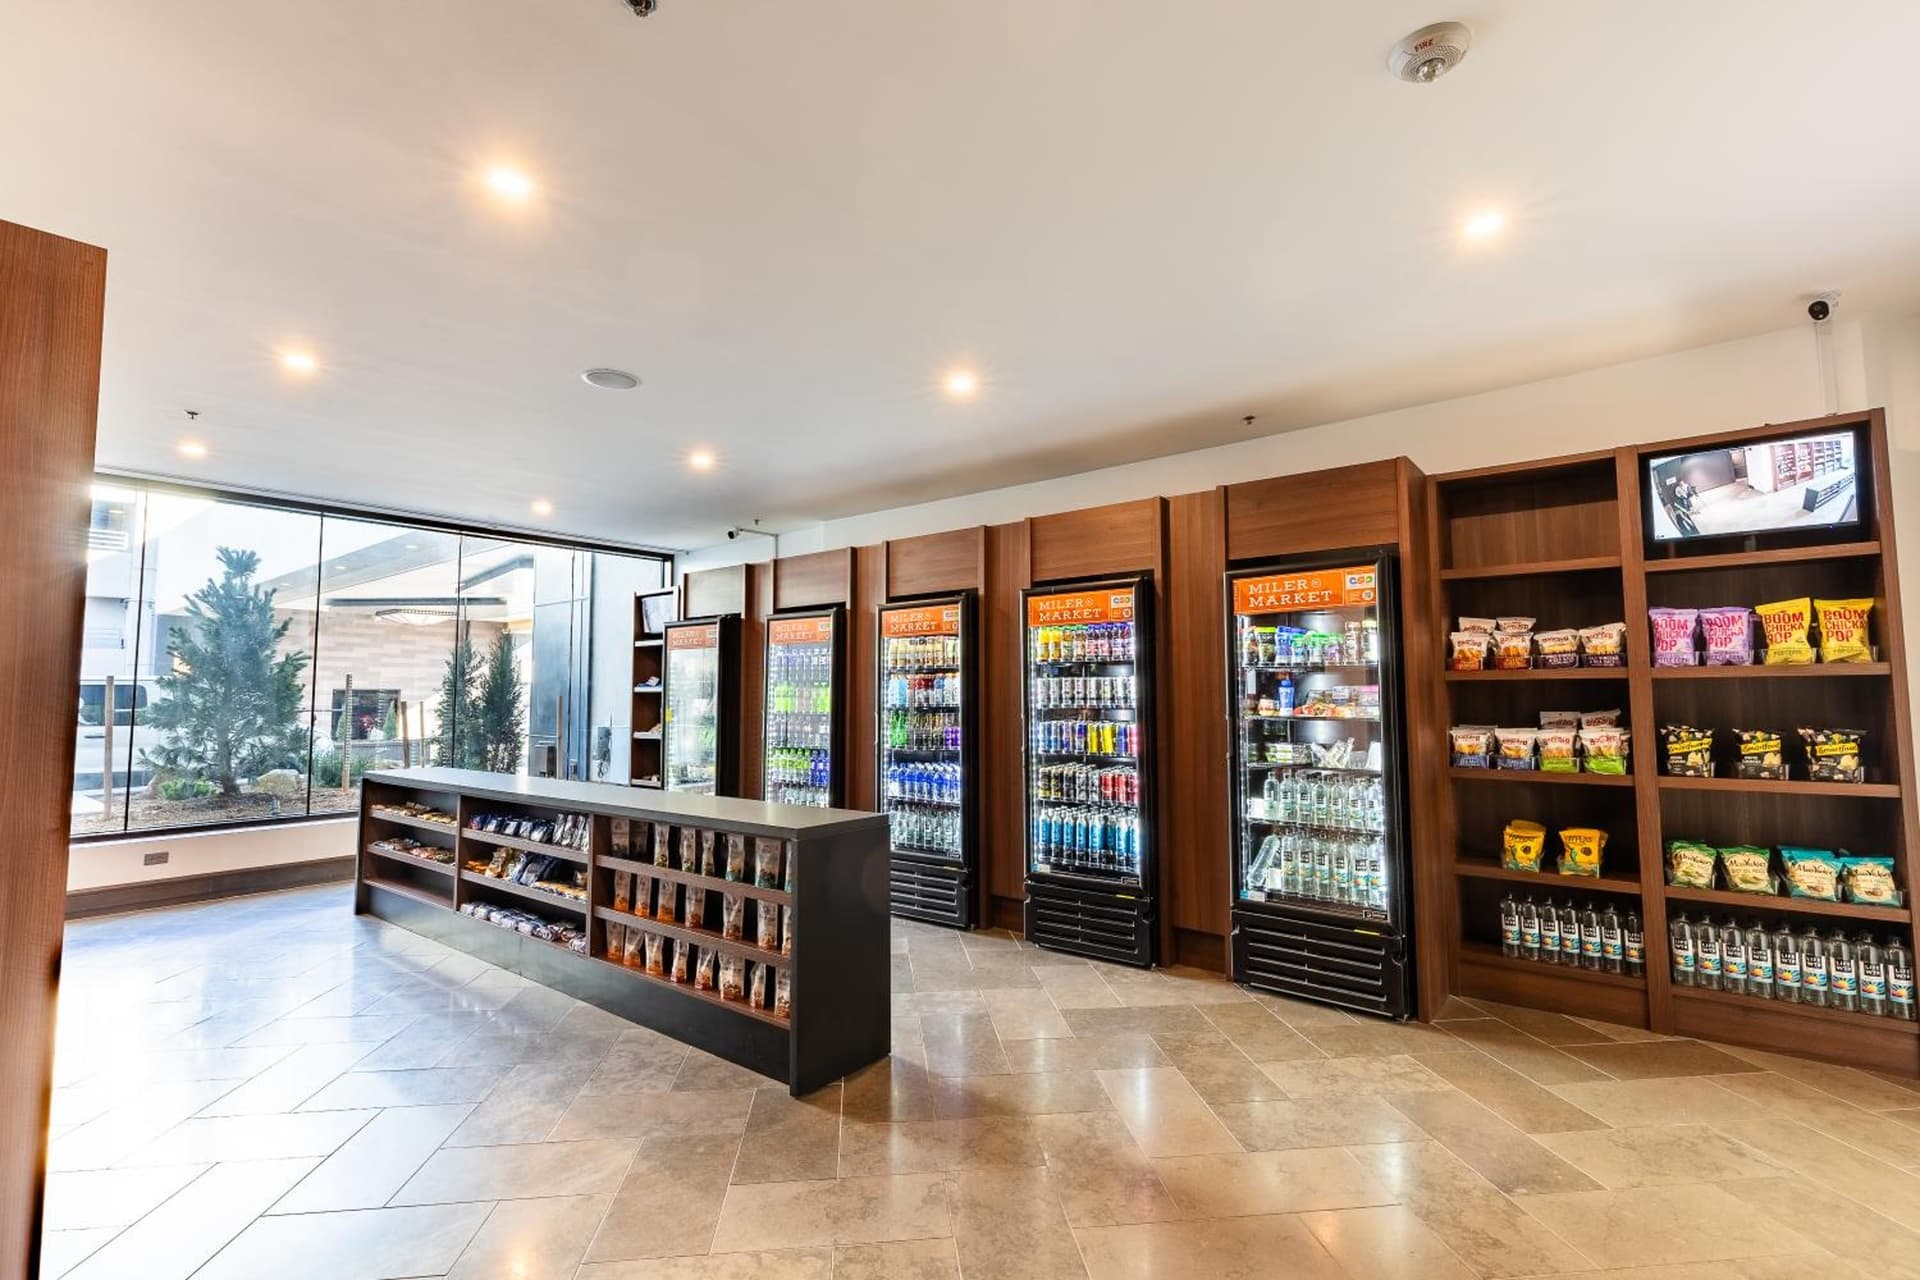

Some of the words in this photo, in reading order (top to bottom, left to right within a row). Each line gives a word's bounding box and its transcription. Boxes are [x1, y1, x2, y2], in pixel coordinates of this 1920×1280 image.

[1414, 39, 1434, 52] FIRE
[1248, 579, 1308, 595] MILER
[1039, 598, 1083, 611] MILER
[1248, 590, 1333, 607] MARKET
[1039, 608, 1102, 622] MARKET
[1705, 615, 1744, 628] BOOM
[1764, 611, 1804, 625] BOOM
[1823, 609, 1866, 621] BOOM
[1765, 623, 1804, 634] CHICKA
[1824, 620, 1866, 630] CHICKA
[1707, 637, 1732, 648] POP
[1767, 632, 1792, 645] POP
[1826, 630, 1853, 642] POP
